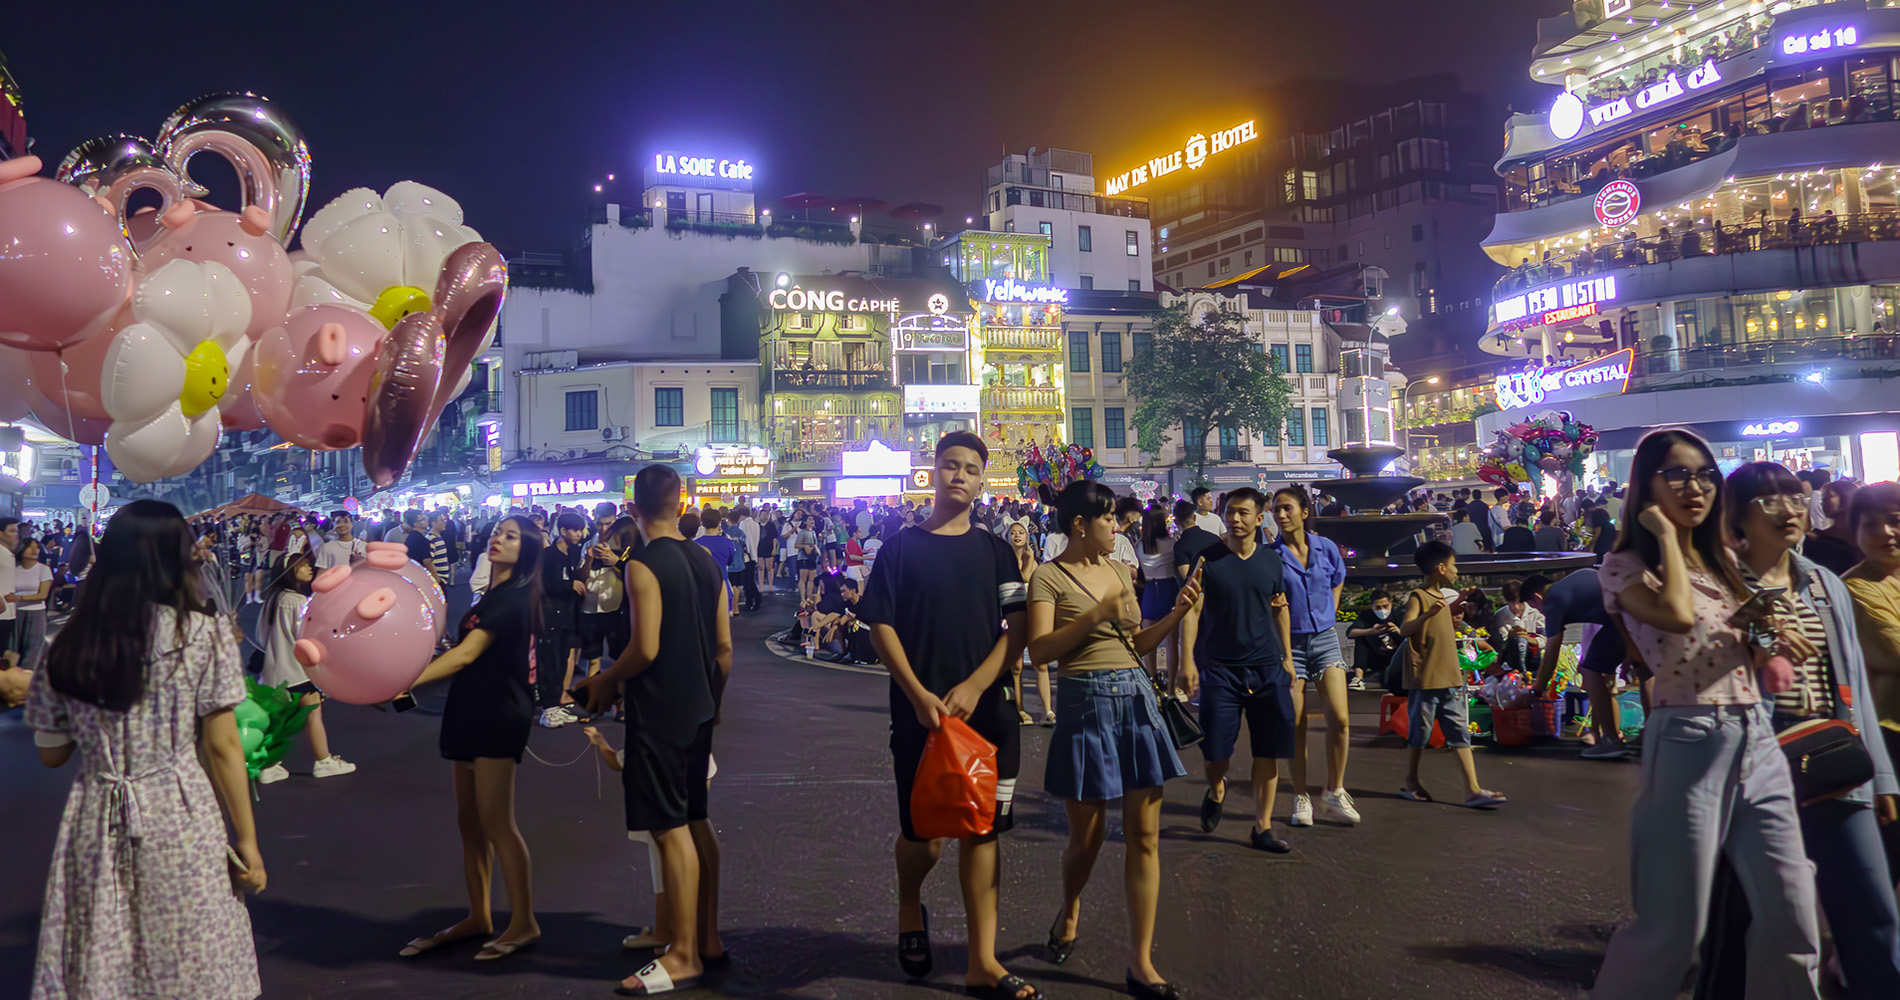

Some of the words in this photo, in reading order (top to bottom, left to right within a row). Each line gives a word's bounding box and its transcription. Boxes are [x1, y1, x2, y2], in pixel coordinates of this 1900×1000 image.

[1833, 27, 1856, 46] 10
[656, 154, 677, 174] LA
[679, 156, 716, 176] SOIE
[719, 159, 753, 179] Cafe
[1106, 172, 1129, 196] MAY
[1132, 165, 1148, 187] DE
[1149, 151, 1183, 178] VILLE
[1211, 120, 1258, 154] HOTEL
[1596, 183, 1637, 207] HIGHLANDS
[1602, 209, 1634, 225] COFFEE
[1565, 364, 1628, 387] CRYSTAL
[1741, 421, 1800, 436] ALDO
